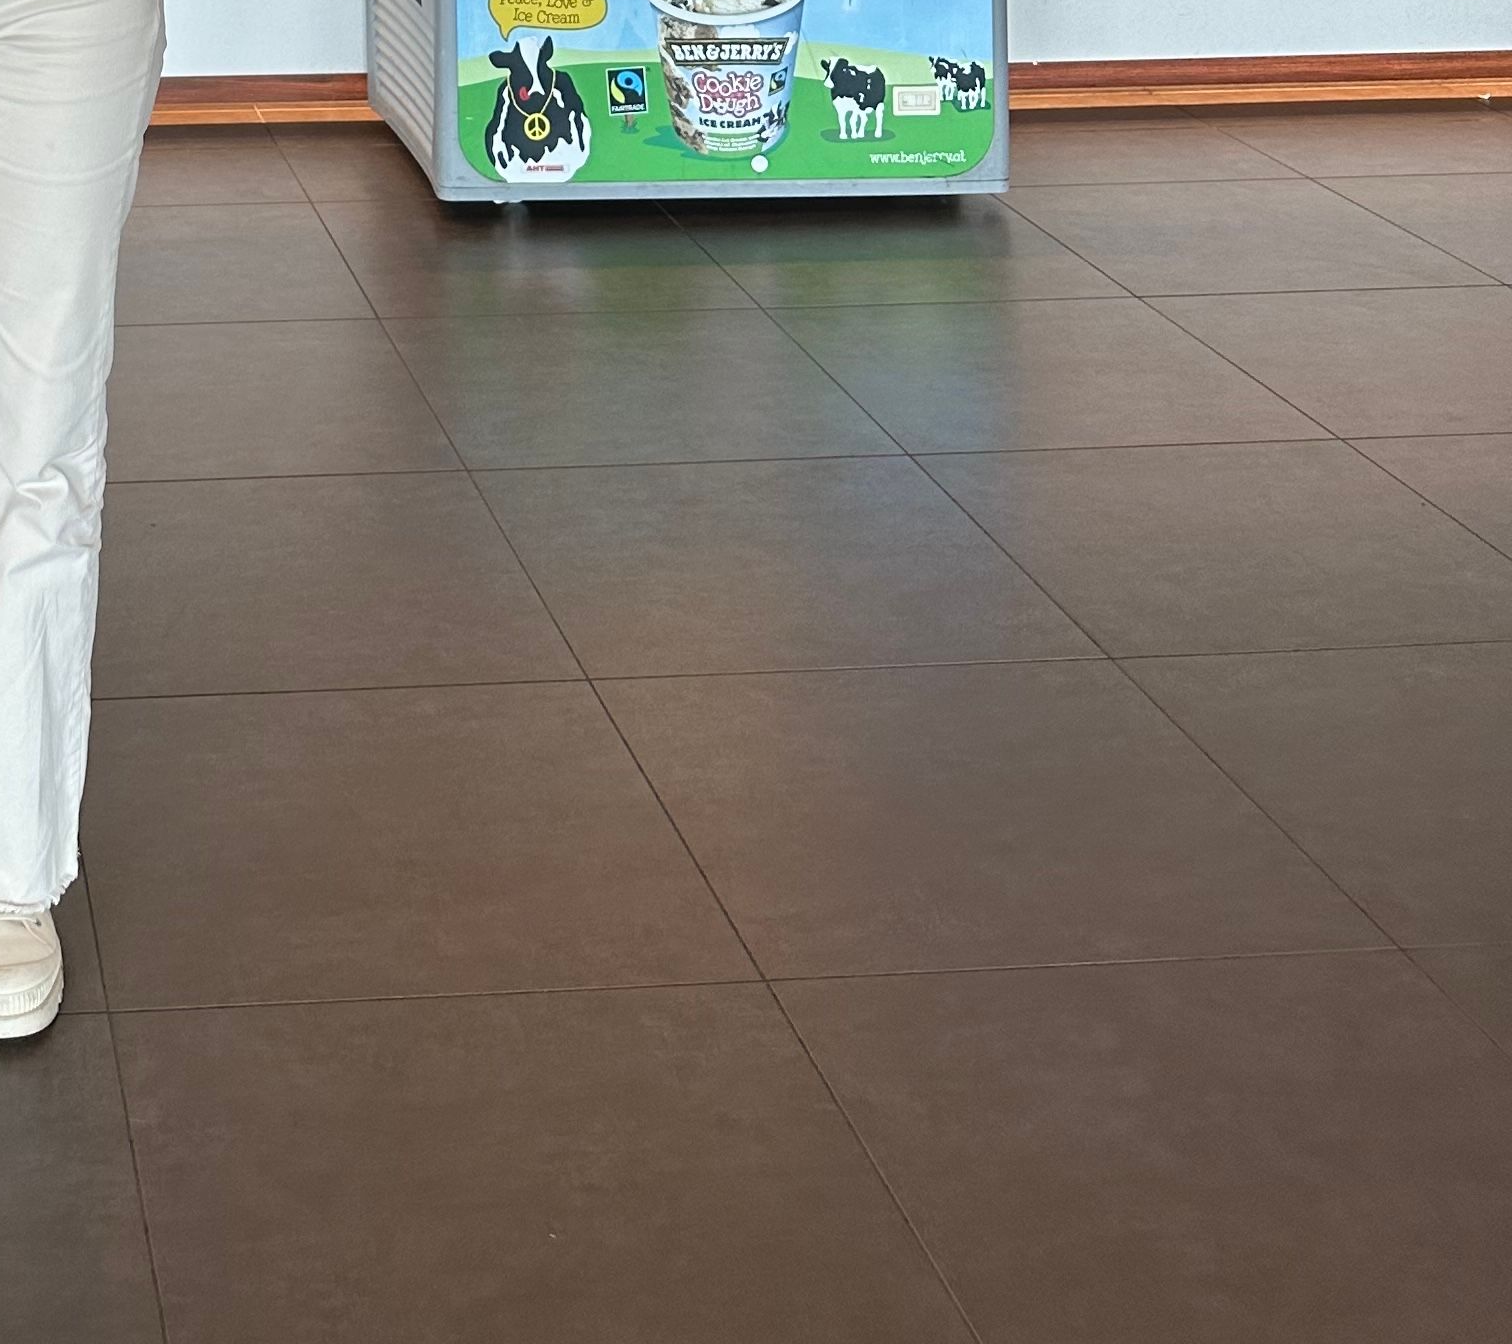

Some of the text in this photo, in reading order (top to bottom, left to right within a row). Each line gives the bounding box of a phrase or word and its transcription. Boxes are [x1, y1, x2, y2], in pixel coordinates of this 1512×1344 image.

[513, 8, 580, 24] Ice Cream
[692, 71, 764, 98] Cookie
[699, 93, 762, 118] Dough
[699, 117, 760, 128] ICE CREAM
